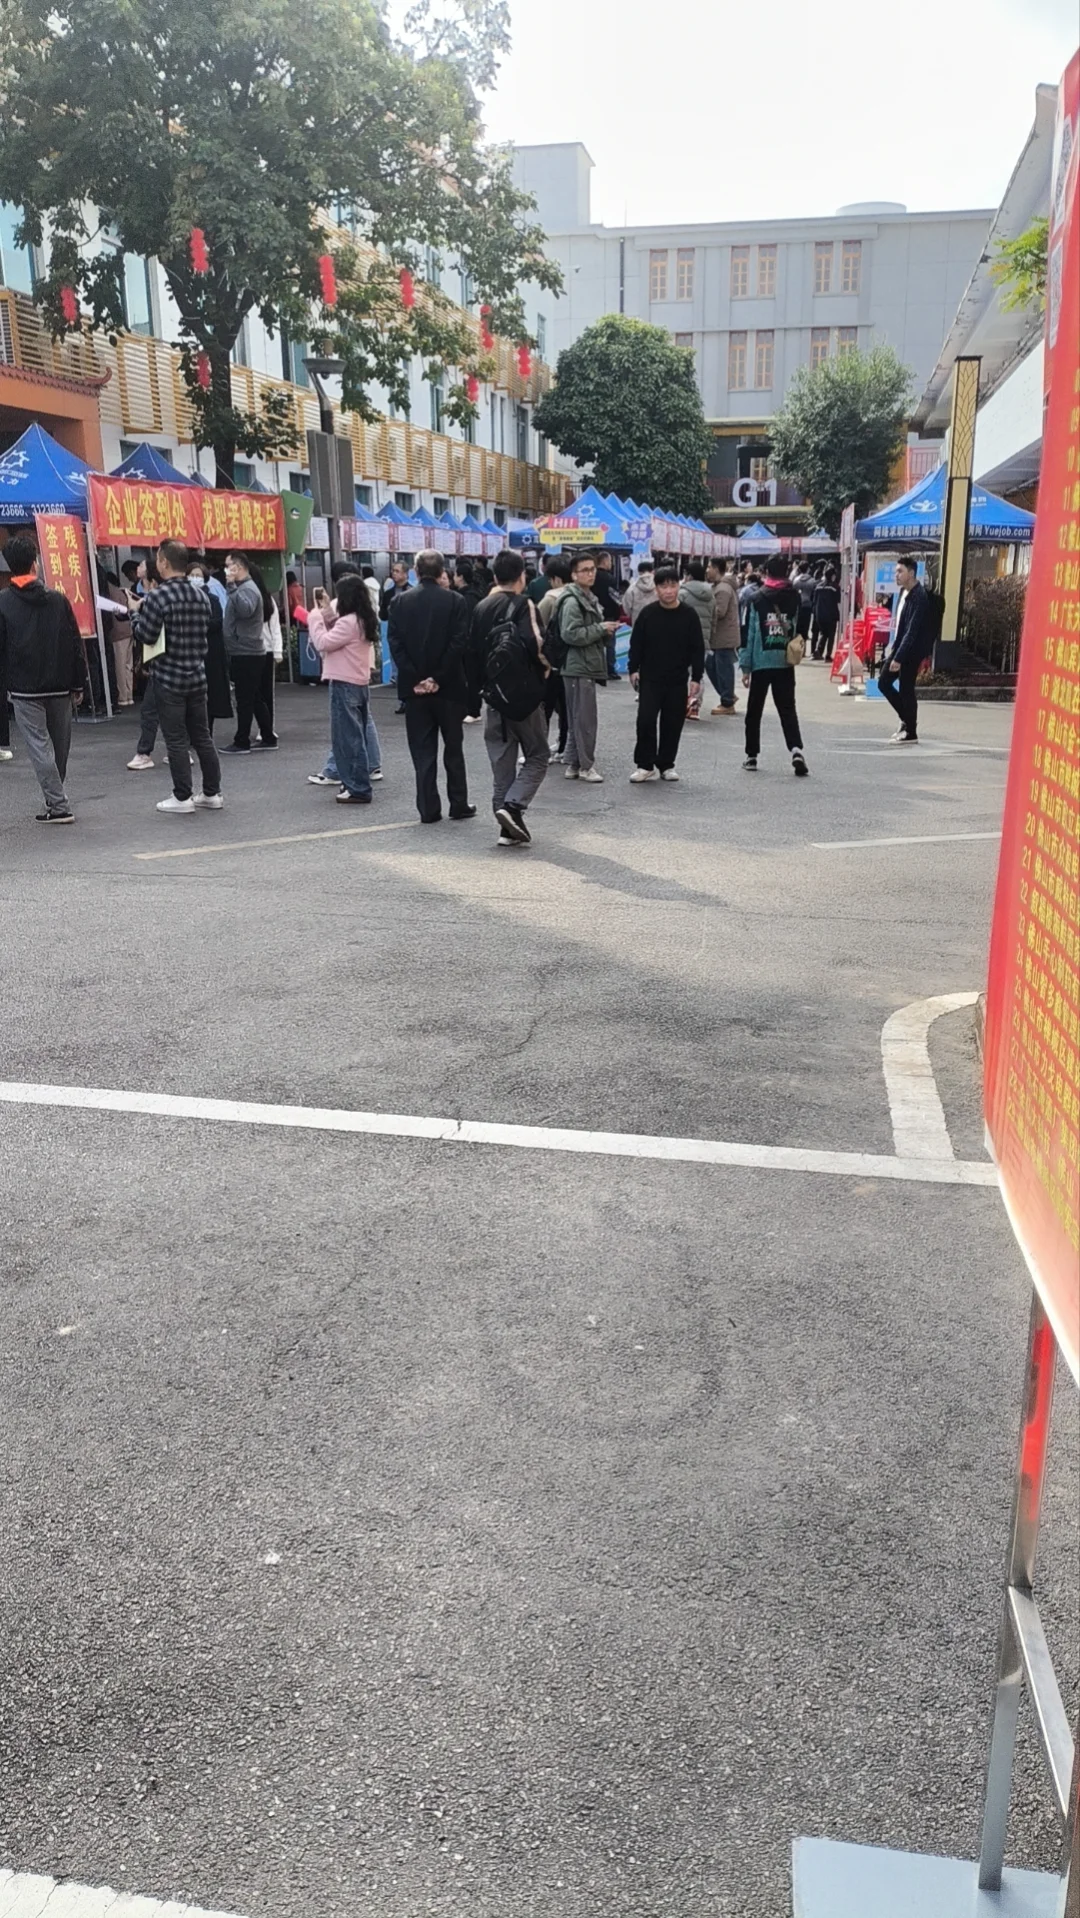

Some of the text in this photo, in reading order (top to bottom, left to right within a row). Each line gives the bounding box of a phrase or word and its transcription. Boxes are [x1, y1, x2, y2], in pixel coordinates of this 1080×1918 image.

[732, 477, 777, 508] G1
[106, 485, 187, 537] 企业签到处
[202, 495, 277, 542] 求职者服务台
[874, 525, 920, 538] 网络求职招聘
[985, 525, 1031, 538] Yuejob.com
[64, 525, 84, 603] 残疾人
[1055, 562, 1063, 586] 13
[1050, 600, 1059, 624] 14
[1045, 637, 1054, 661] 15
[1041, 673, 1050, 697] 16
[1037, 709, 1080, 757] 17 佛山市金
[1033, 743, 1042, 768] 18
[1030, 779, 1039, 803] 19
[1025, 811, 1035, 837] 20
[1022, 845, 1031, 870] 21
[1020, 877, 1028, 904] 22
[1018, 911, 1026, 936] 23
[1015, 974, 1022, 999] 25
[1016, 942, 1080, 1046] 24 佛山智多鑫管理
[1011, 1037, 1019, 1061] 27
